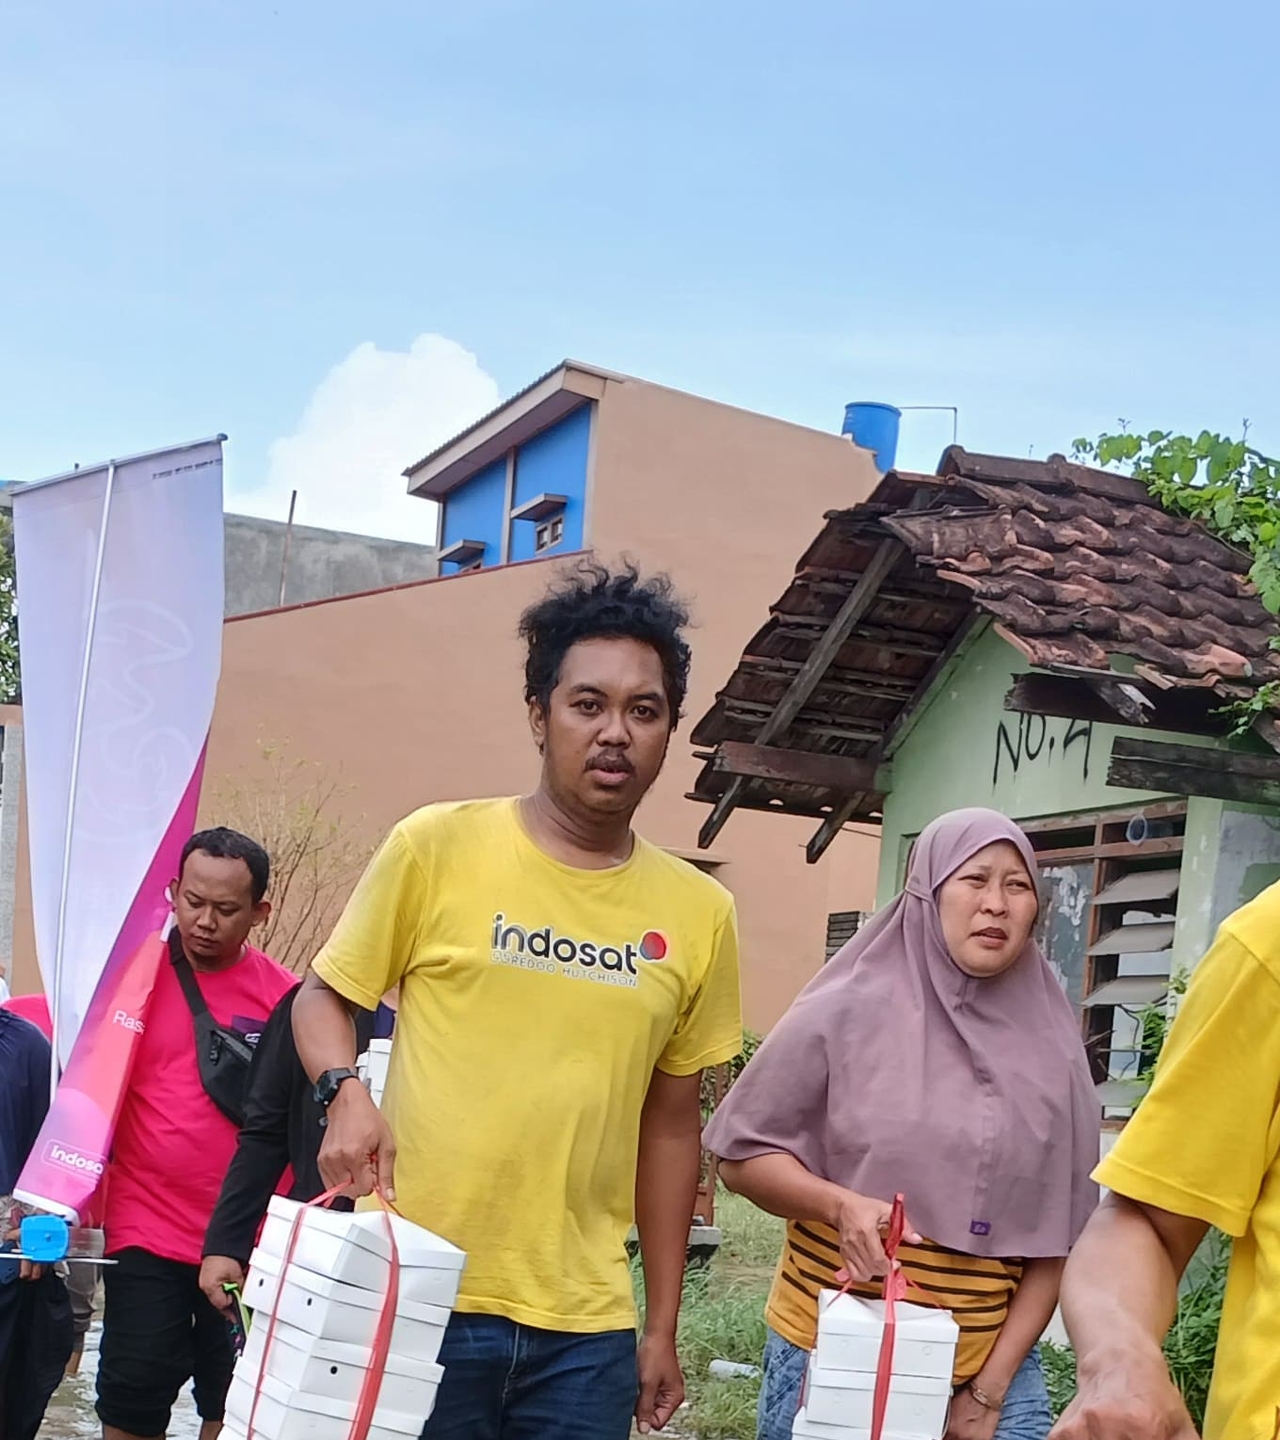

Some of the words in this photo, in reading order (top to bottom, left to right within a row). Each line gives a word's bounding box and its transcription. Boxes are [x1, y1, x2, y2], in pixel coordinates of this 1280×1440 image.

[491, 913, 638, 976] indosat
[491, 951, 557, 974] OOREDOO
[562, 967, 638, 988] HUTCHISON
